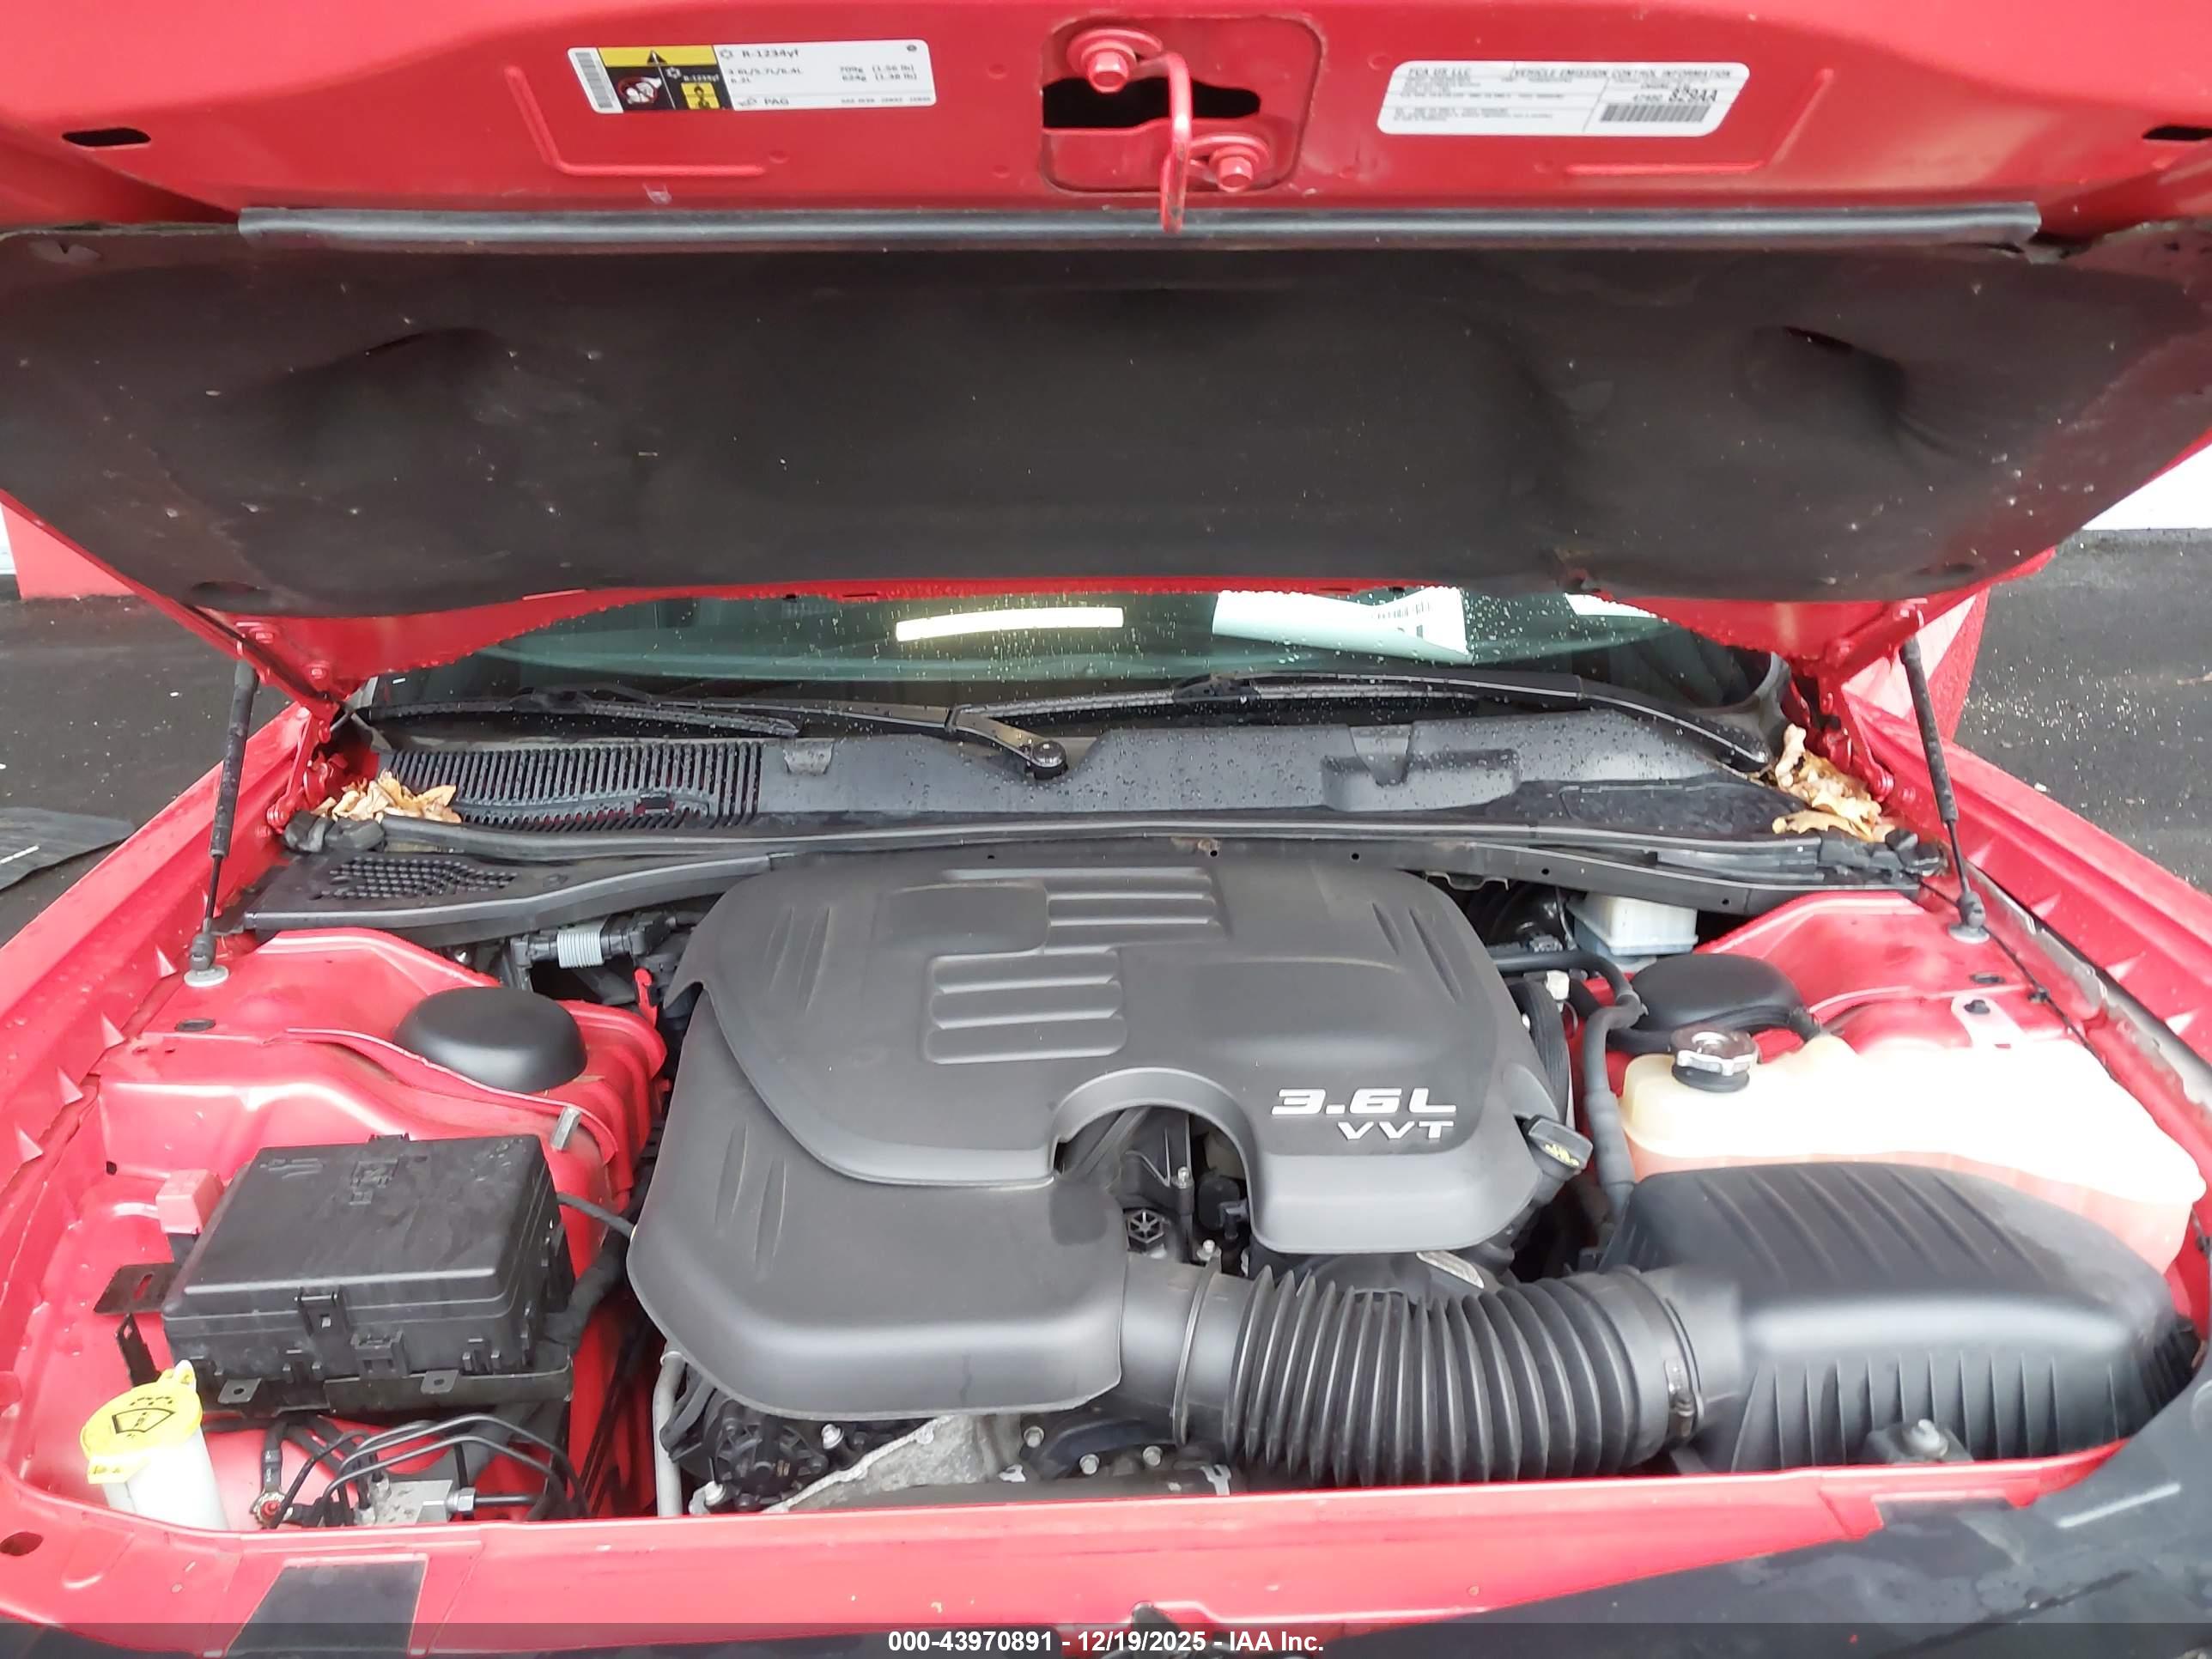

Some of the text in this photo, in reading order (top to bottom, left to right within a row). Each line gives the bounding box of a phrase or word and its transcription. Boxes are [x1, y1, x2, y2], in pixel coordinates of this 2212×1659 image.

[742, 49, 799, 58] R-1234yf
[1662, 69, 1731, 78] INFORMATION
[764, 98, 790, 106] PAG
[1272, 1088, 1457, 1115] 3.6L
[1337, 1121, 1454, 1140] VVT
